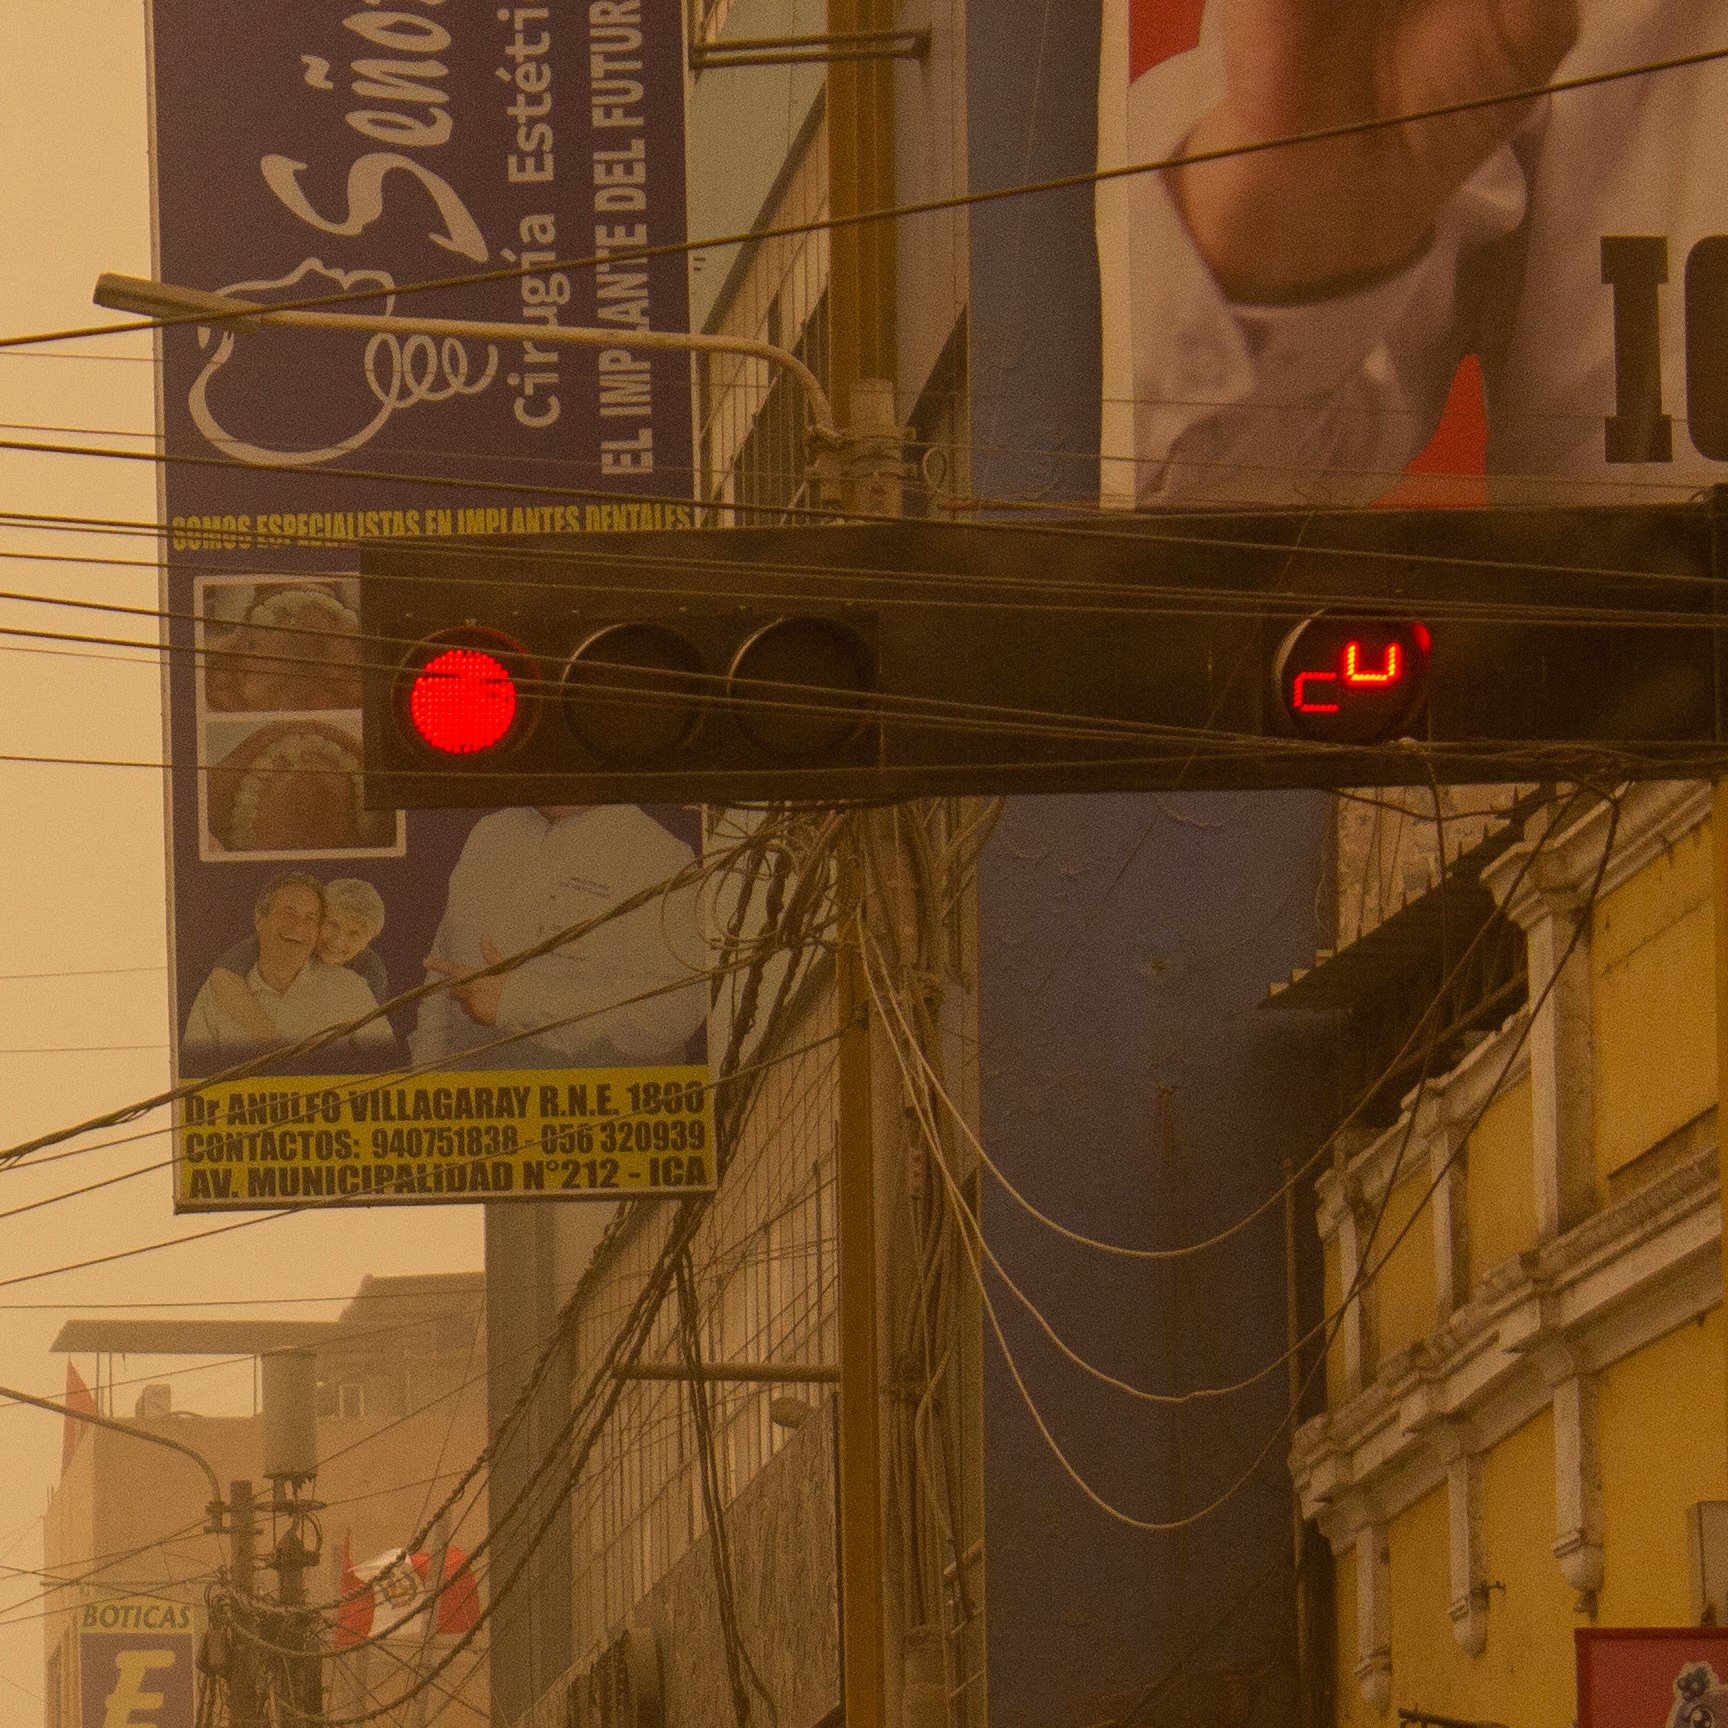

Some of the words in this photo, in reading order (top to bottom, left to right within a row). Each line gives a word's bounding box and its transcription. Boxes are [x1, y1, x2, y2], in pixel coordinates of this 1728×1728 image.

[261, 0, 489, 263] Seño
[592, 139, 648, 212] DEL
[500, 213, 570, 428] Cirugía
[594, 225, 654, 416] IMPLANTE
[600, 427, 655, 476] EL
[425, 507, 455, 537] EN
[458, 504, 579, 535] IMPLANTES
[585, 503, 691, 532] DENTALES
[185, 1096, 220, 1126] Dr
[226, 1090, 342, 1124] ANULFO
[350, 1086, 531, 1123] VILLAGARAY
[540, 1084, 620, 1118] R.N.E.
[186, 1130, 360, 1163] CONTACTOS:
[370, 1124, 519, 1158] 940751838
[541, 1123, 594, 1155] 056
[600, 1121, 706, 1153] 320939
[189, 1167, 238, 1200] AV.
[247, 1161, 513, 1198] MUNICIPALIDAD
[649, 1156, 707, 1187] ICA
[82, 1603, 191, 1629] BOTICAS
